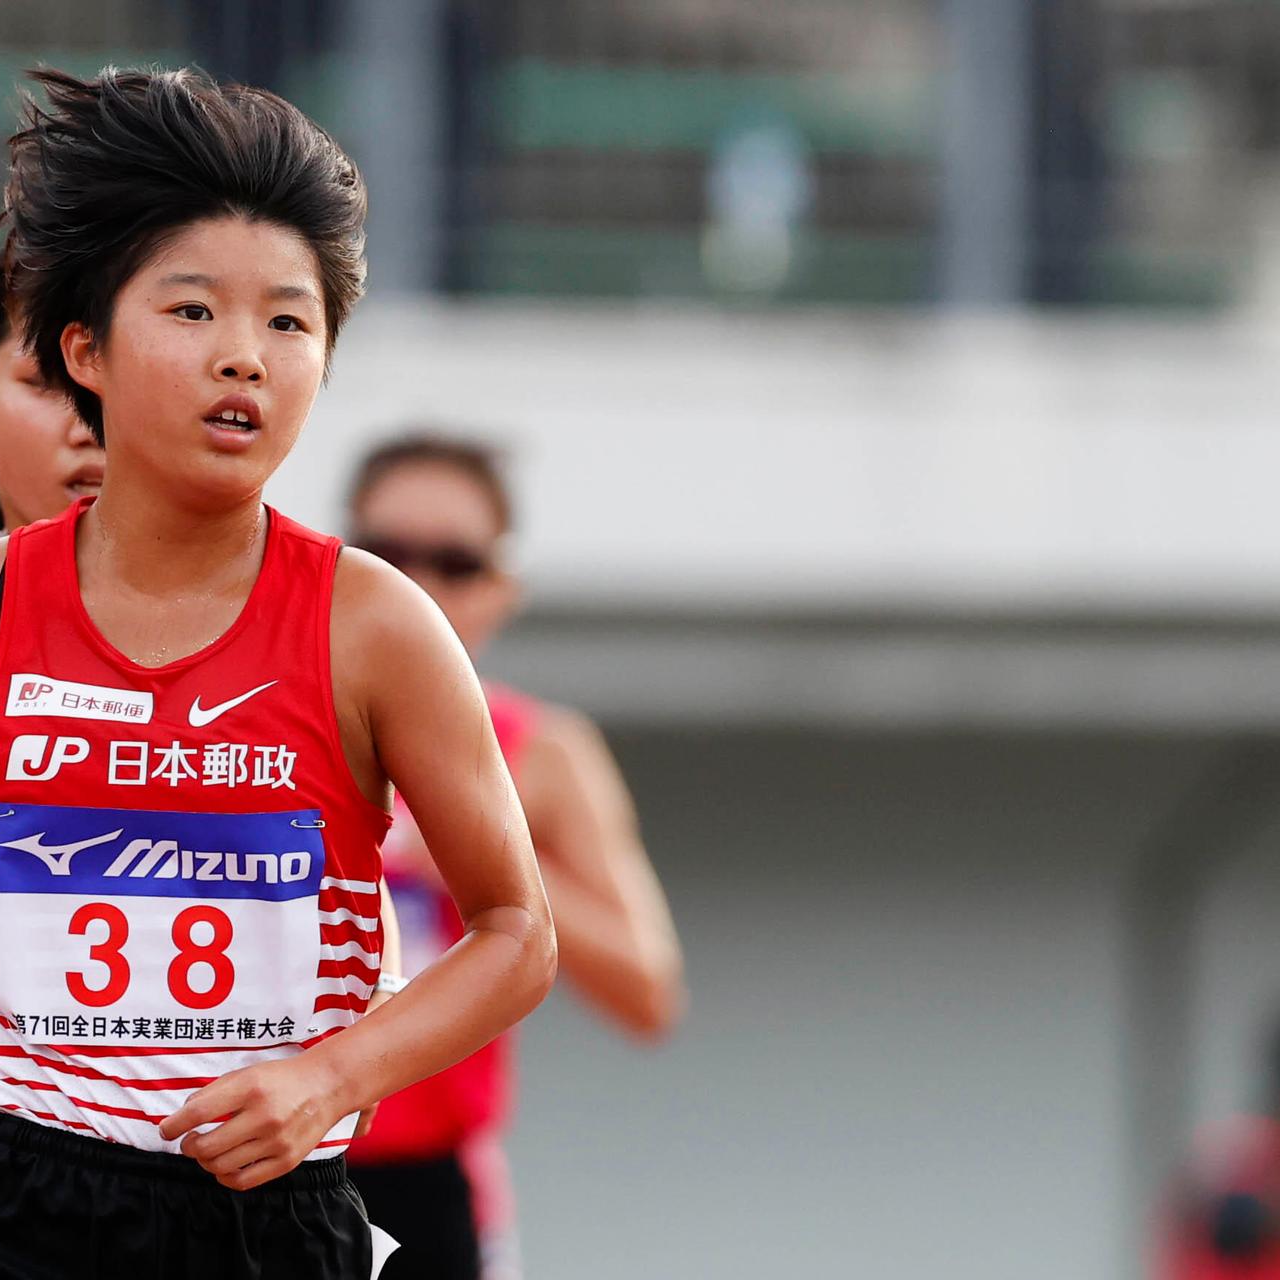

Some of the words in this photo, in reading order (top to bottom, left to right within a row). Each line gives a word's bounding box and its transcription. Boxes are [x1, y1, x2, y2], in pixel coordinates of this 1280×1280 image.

[61, 692, 145, 719] 日本郵便
[5, 734, 91, 781] JP
[107, 740, 298, 791] 日本郵政
